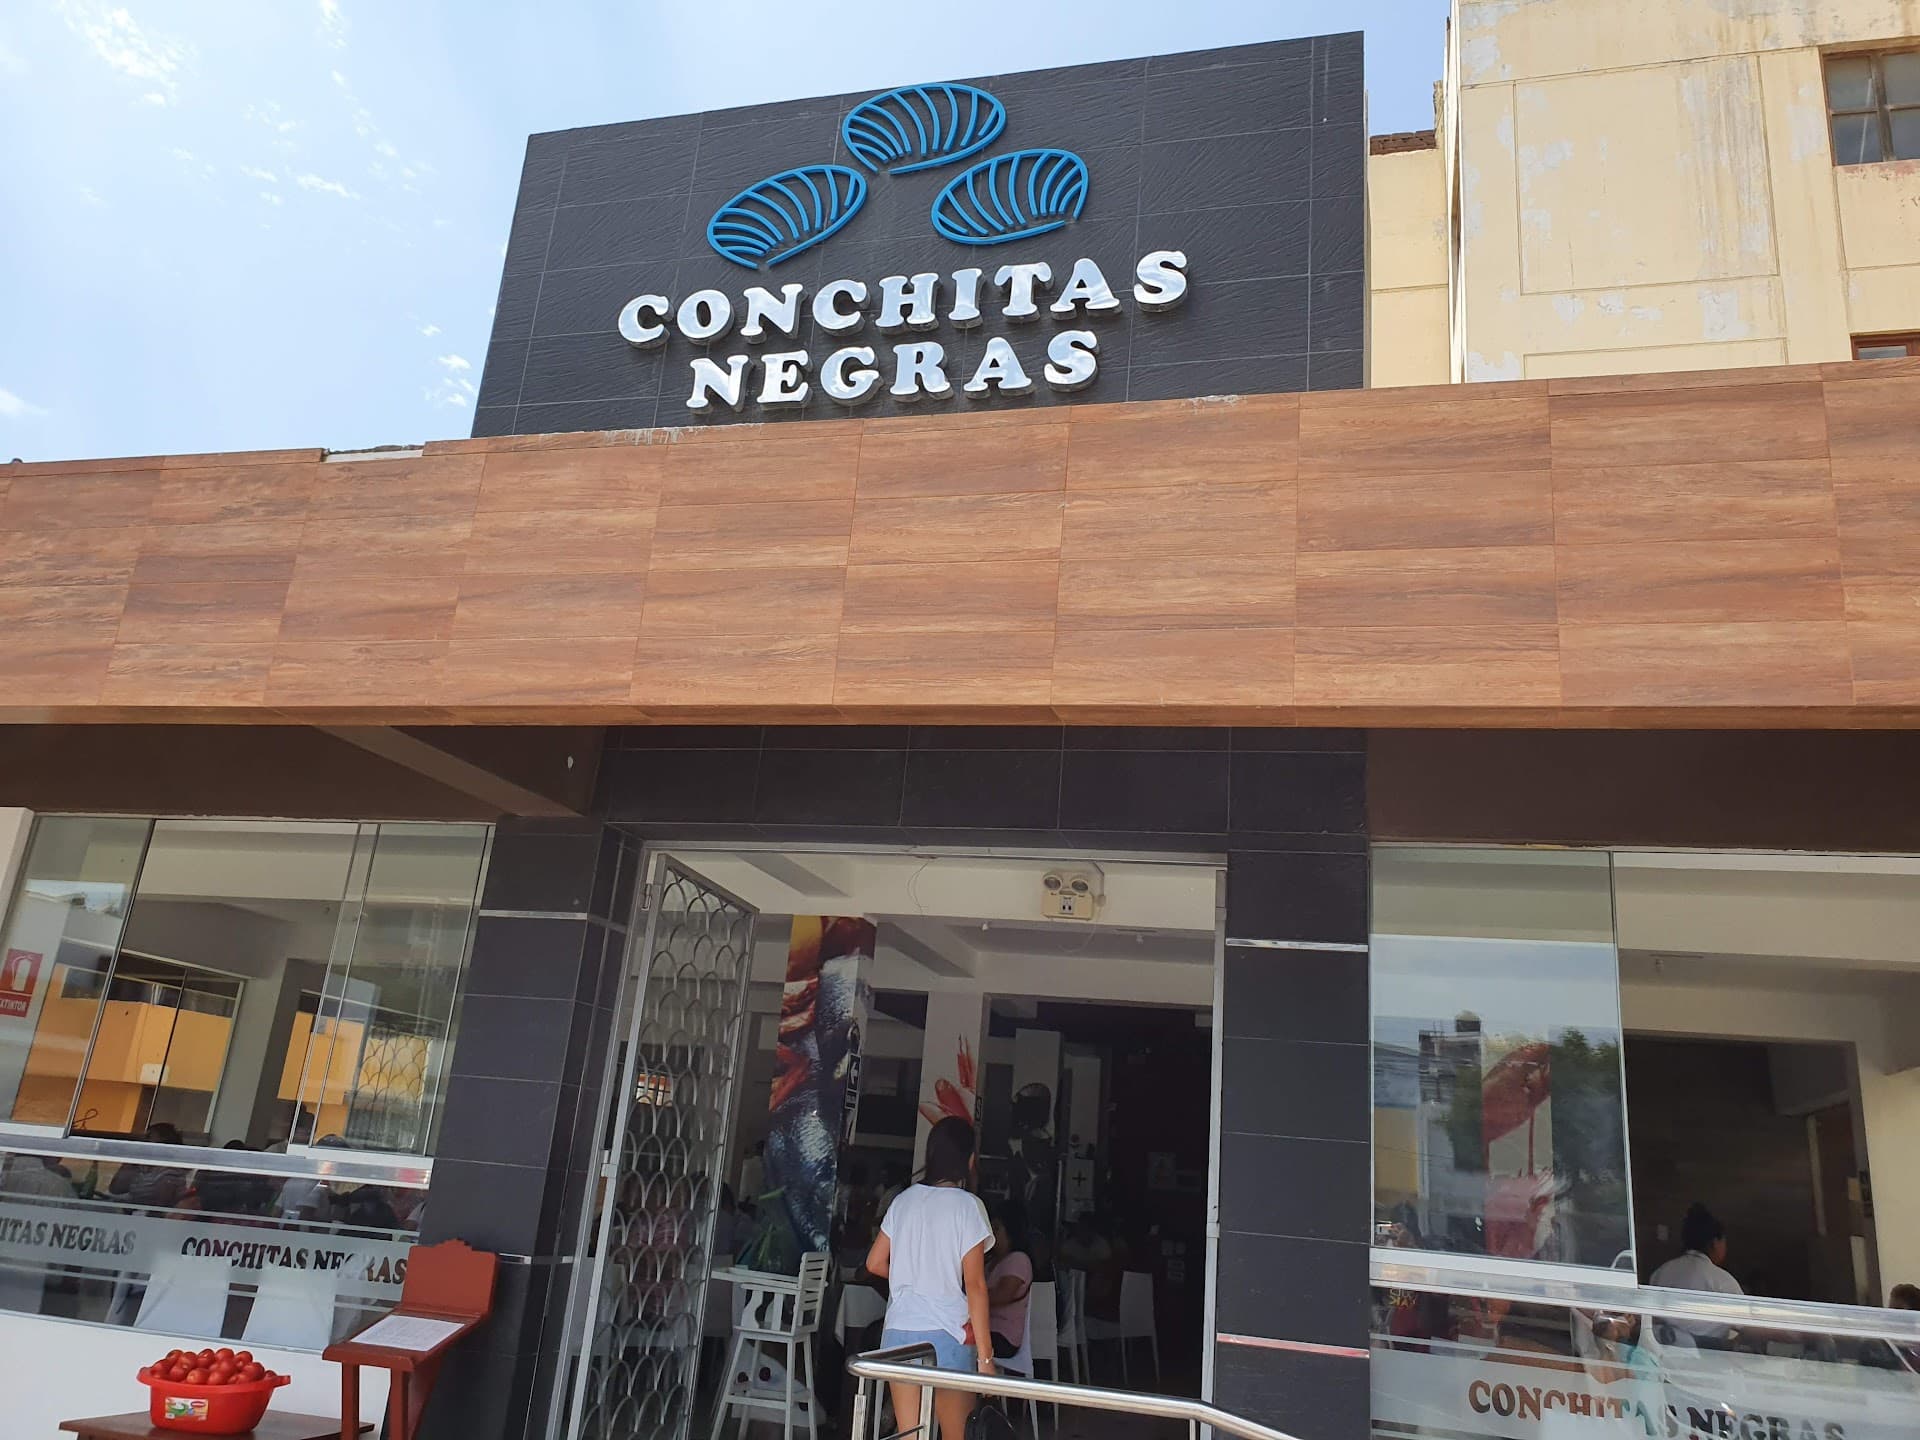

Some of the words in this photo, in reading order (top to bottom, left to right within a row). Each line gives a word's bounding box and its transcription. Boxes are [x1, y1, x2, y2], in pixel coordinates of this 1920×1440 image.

[618, 250, 1190, 347] CONCHITAS
[686, 330, 1098, 409] NEGRAS
[0, 999, 27, 1012] XTINTOR
[0, 1217, 48, 1246] ITAS
[48, 1223, 136, 1255] NEGRAS
[313, 1250, 407, 1284] NEAS
